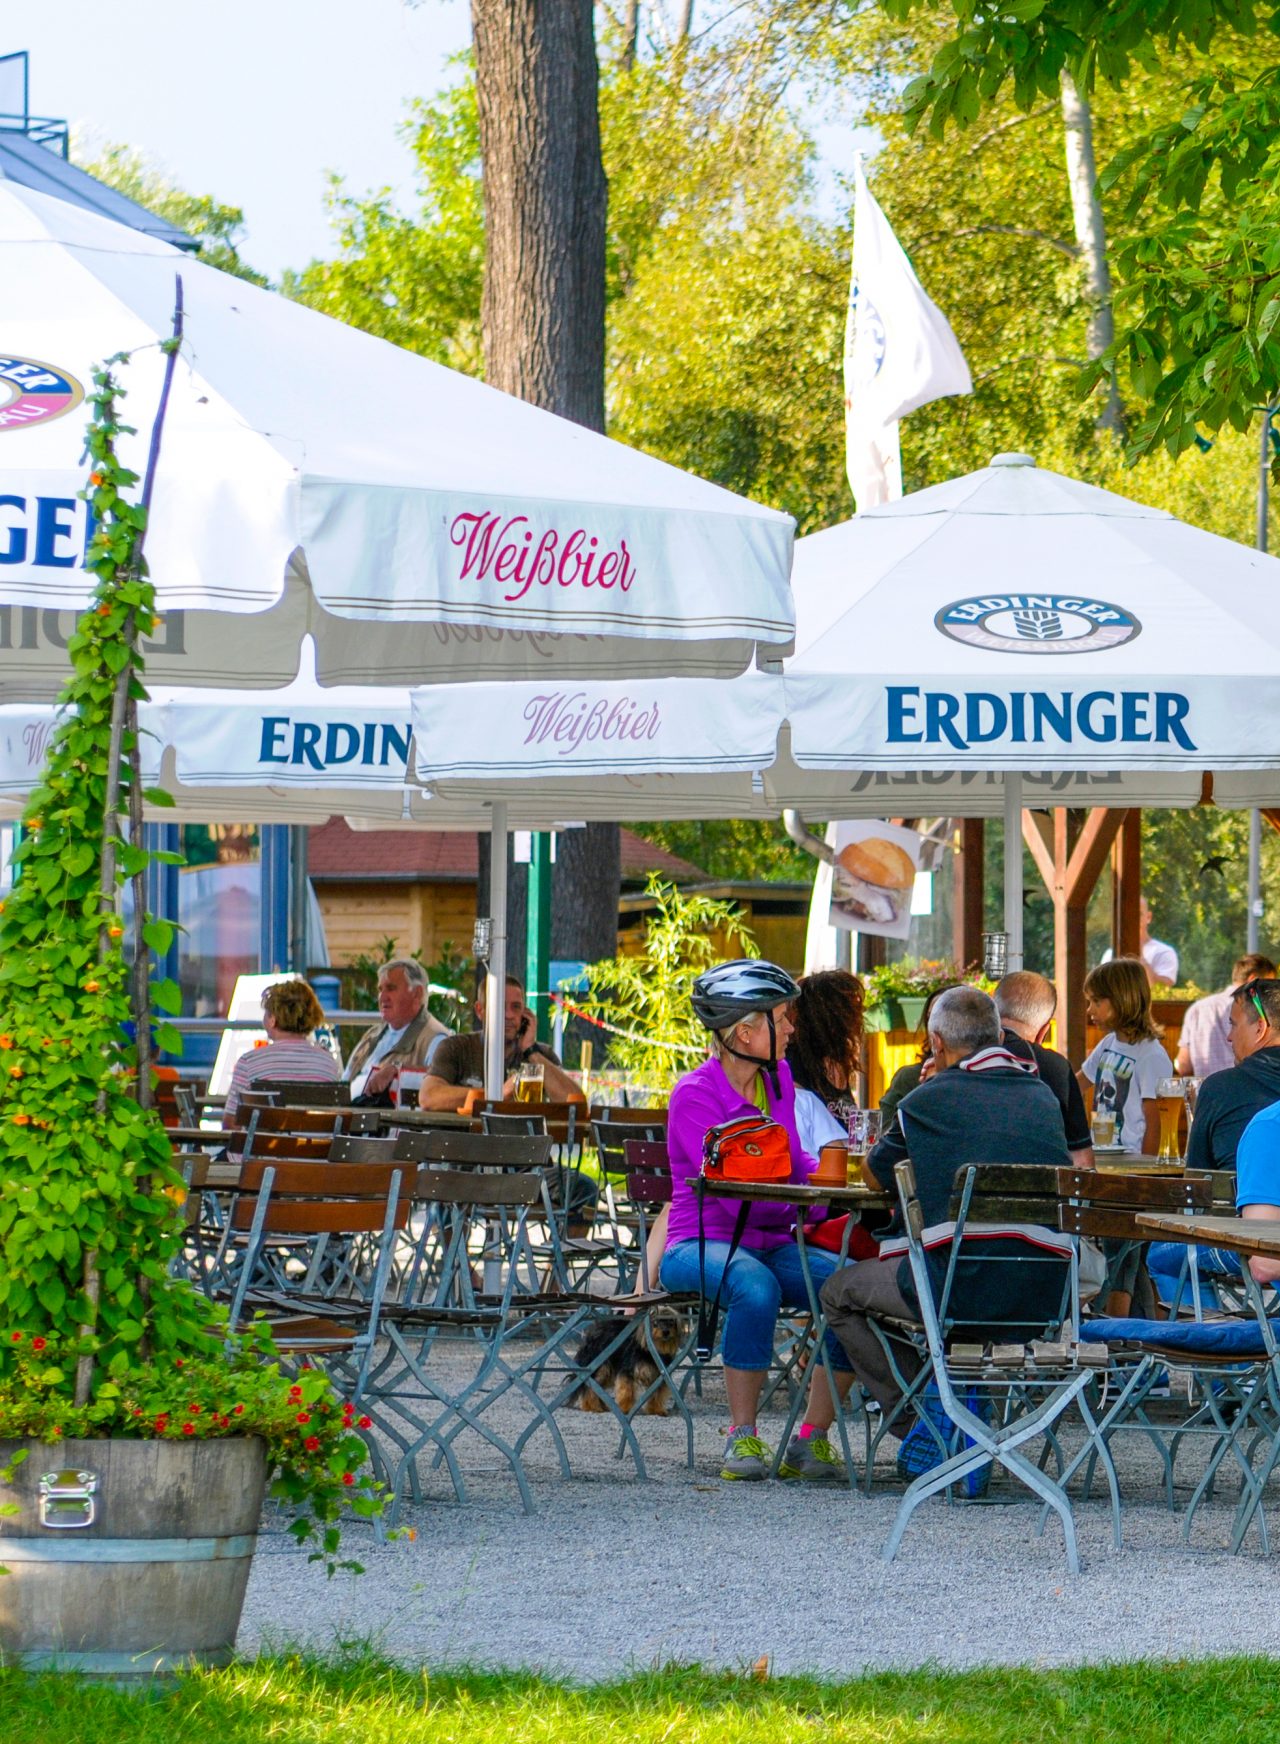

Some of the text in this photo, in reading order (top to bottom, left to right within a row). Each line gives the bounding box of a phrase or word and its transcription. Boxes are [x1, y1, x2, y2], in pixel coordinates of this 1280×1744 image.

[450, 511, 637, 601] Weißbier
[948, 596, 1121, 622] ERDINGER
[523, 692, 662, 755] Weißbier
[885, 686, 1199, 751] ERDINGER
